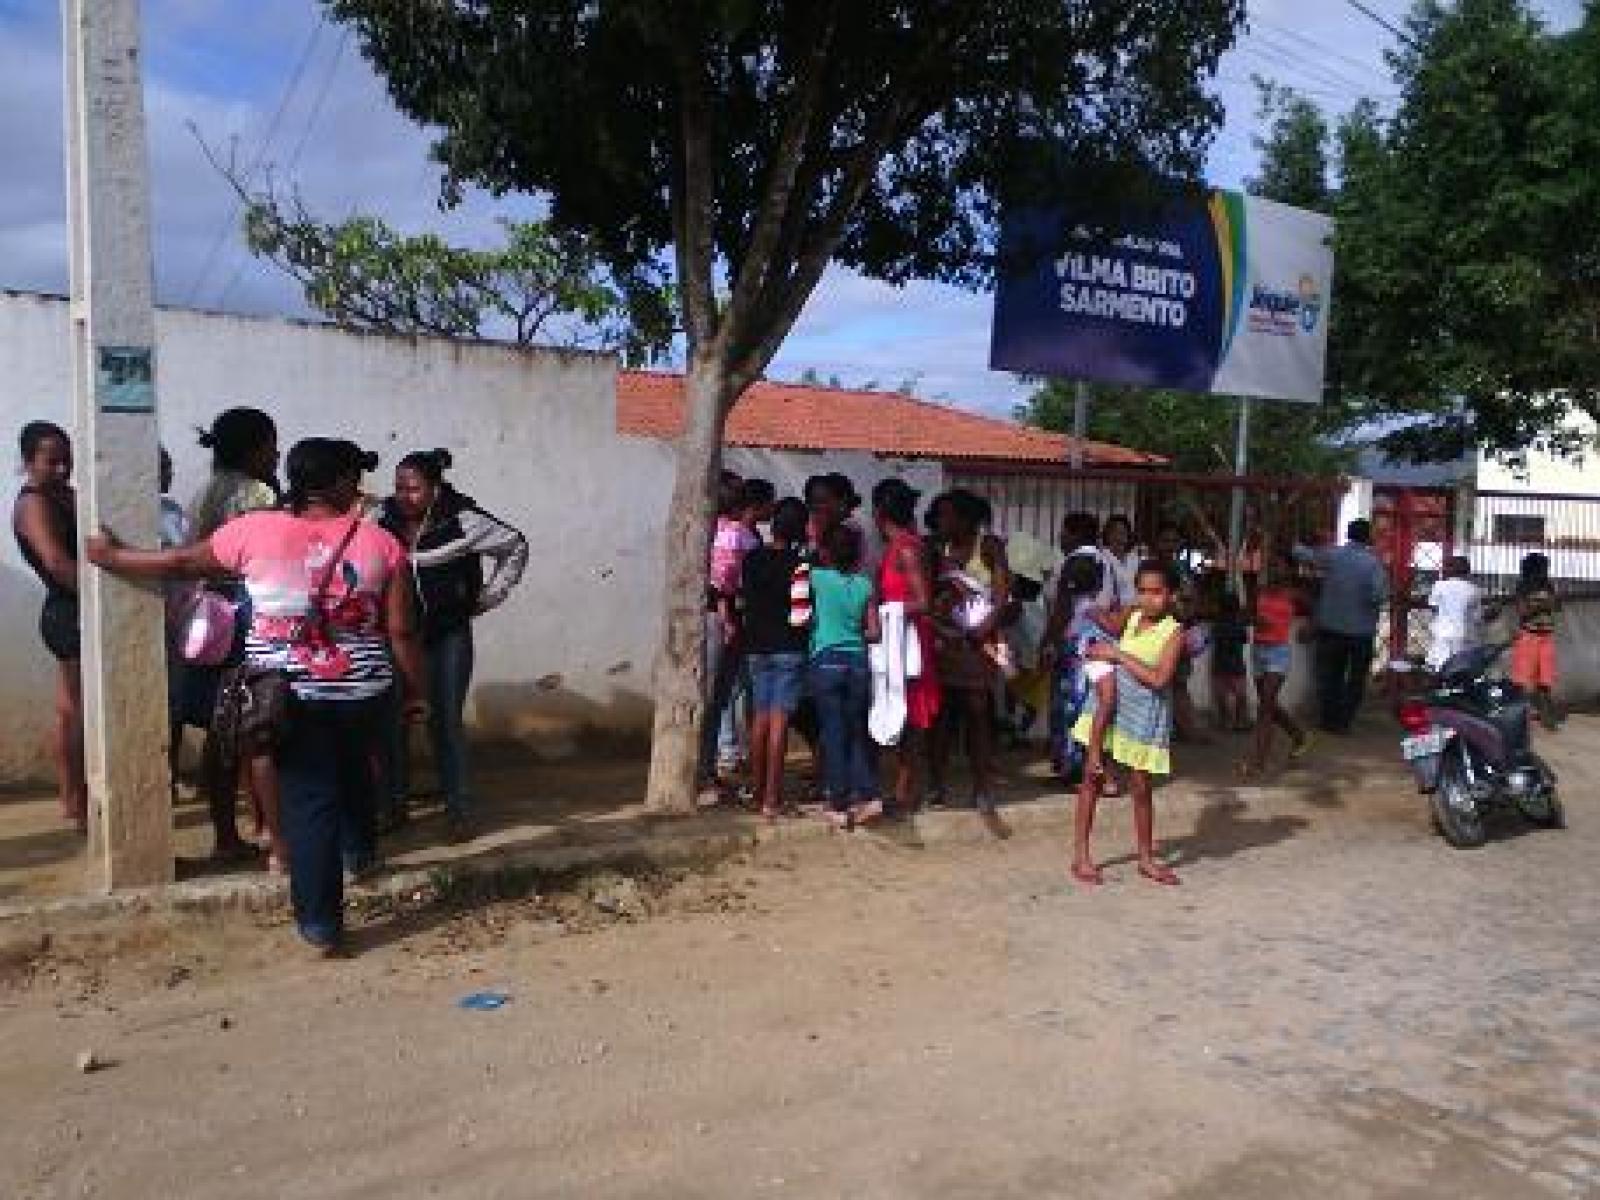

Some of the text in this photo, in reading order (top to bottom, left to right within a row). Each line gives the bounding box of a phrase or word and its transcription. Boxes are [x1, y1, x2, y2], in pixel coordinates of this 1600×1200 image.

[1055, 251, 1196, 299] VILMA BRITO
[1060, 283, 1187, 328] SARMENTO
